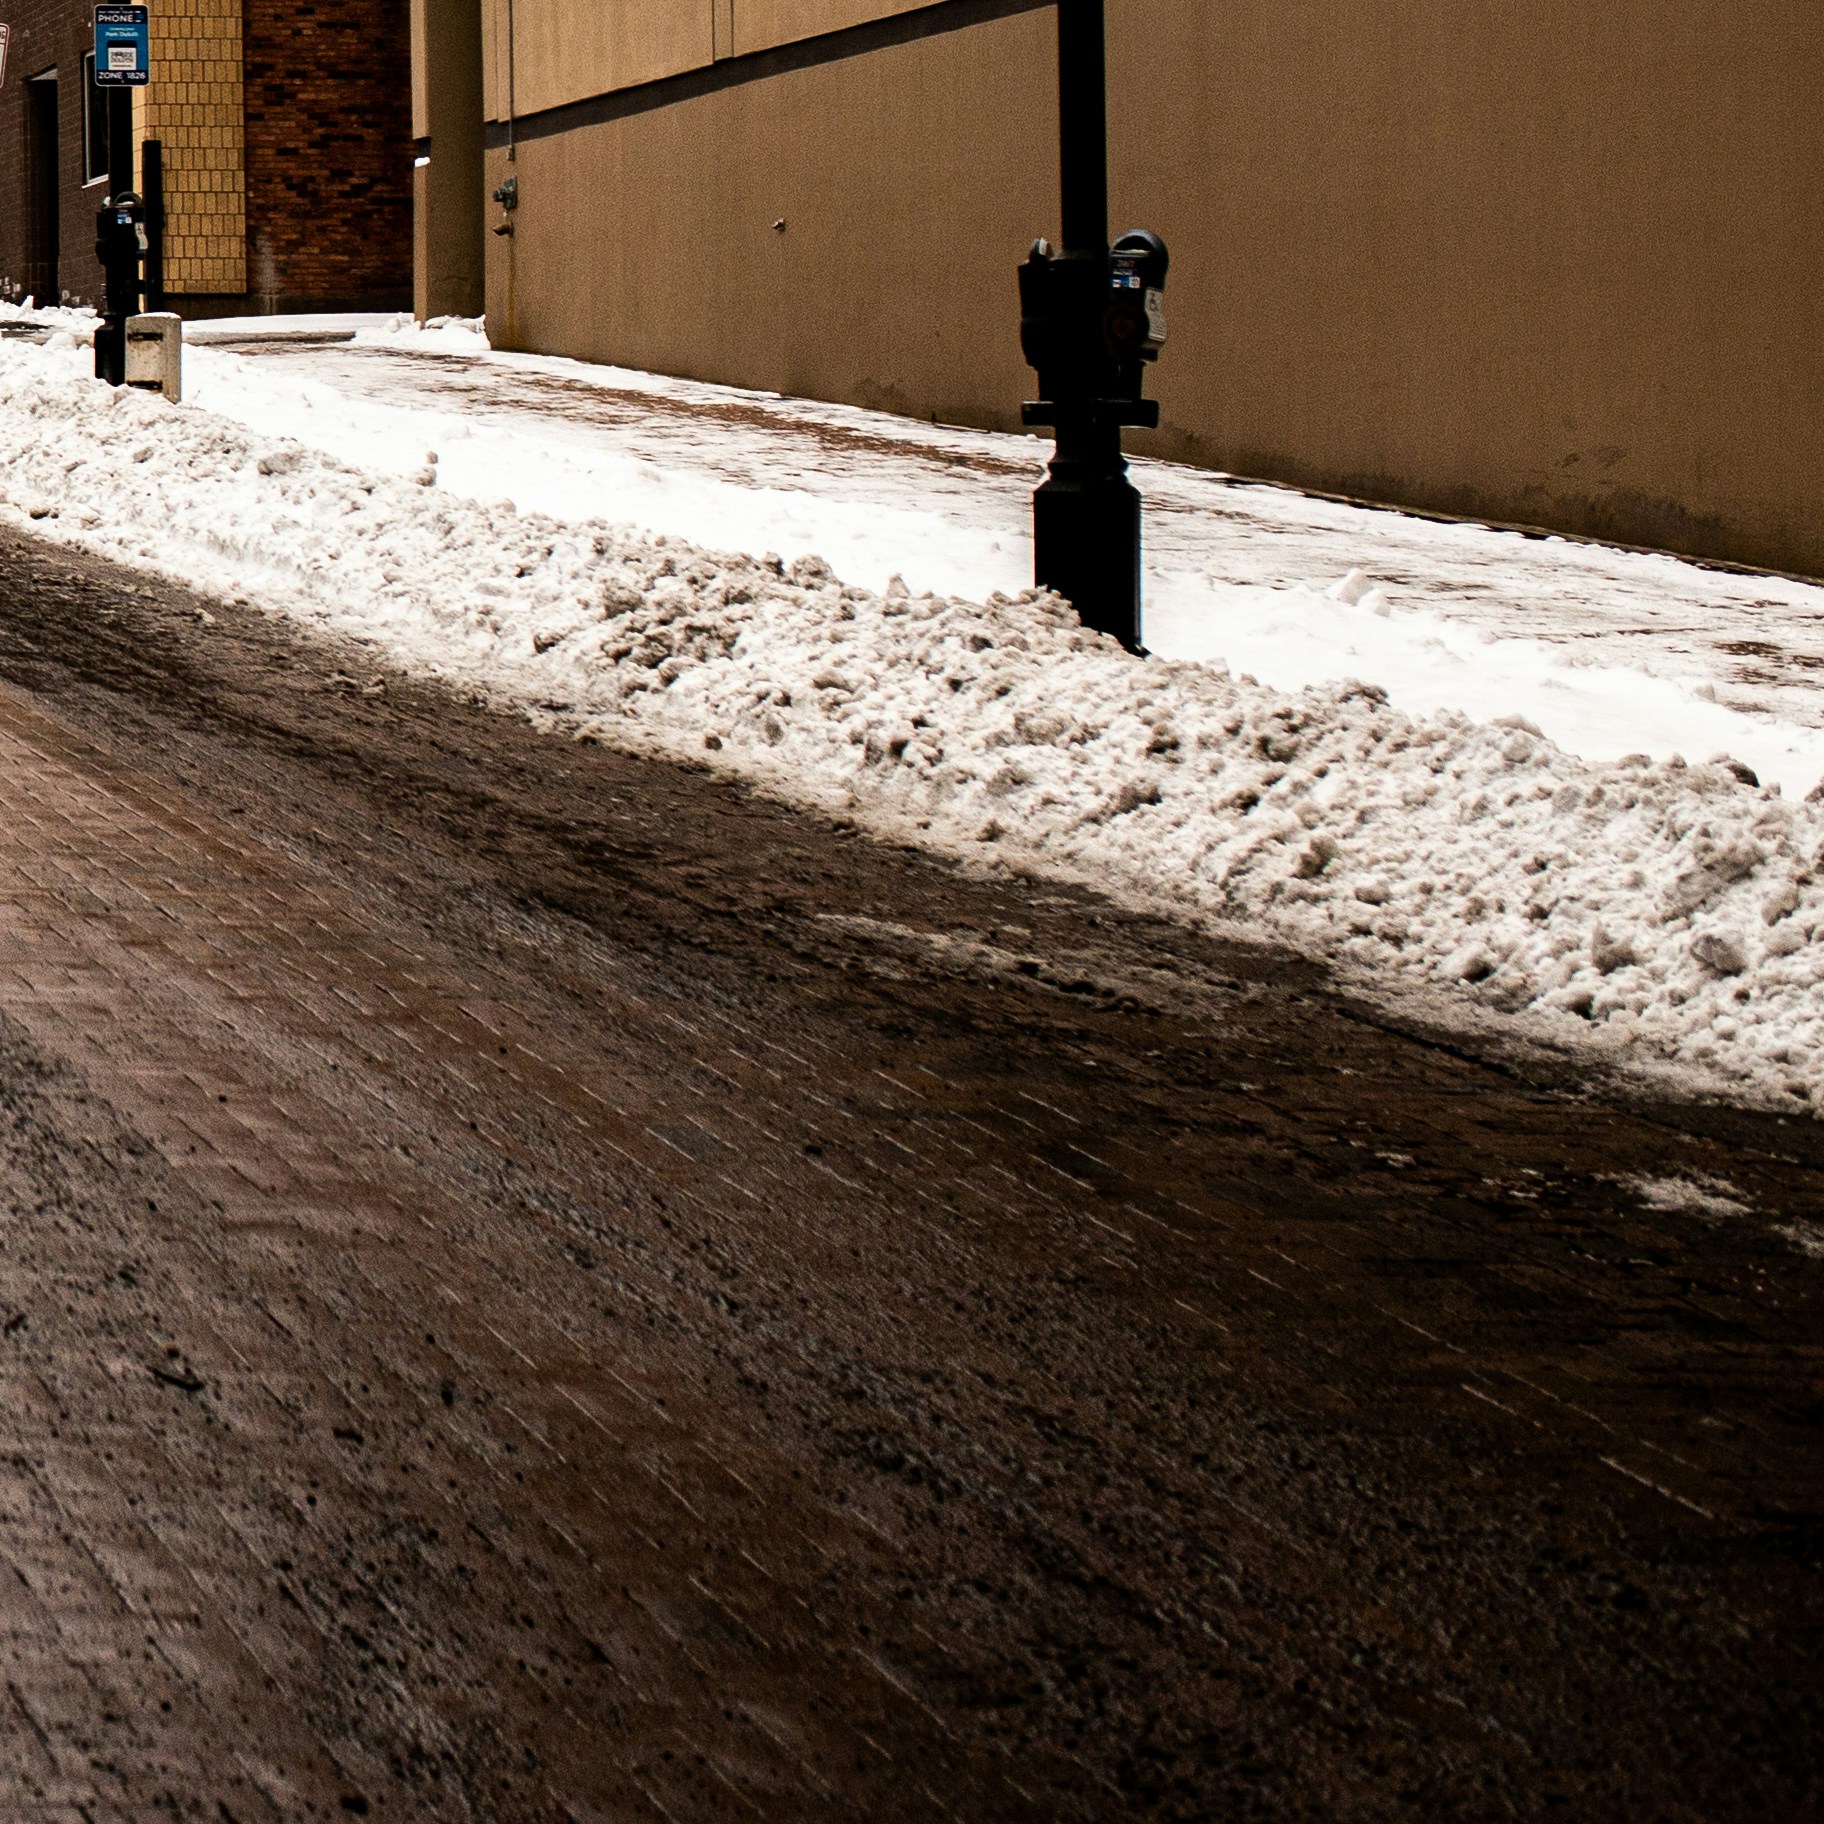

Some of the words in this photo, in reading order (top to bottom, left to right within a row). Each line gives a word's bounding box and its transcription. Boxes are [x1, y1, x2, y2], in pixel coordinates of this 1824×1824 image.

[98, 14, 134, 23] PHONE
[98, 71, 123, 80] ZONE
[126, 71, 147, 80] 1826
